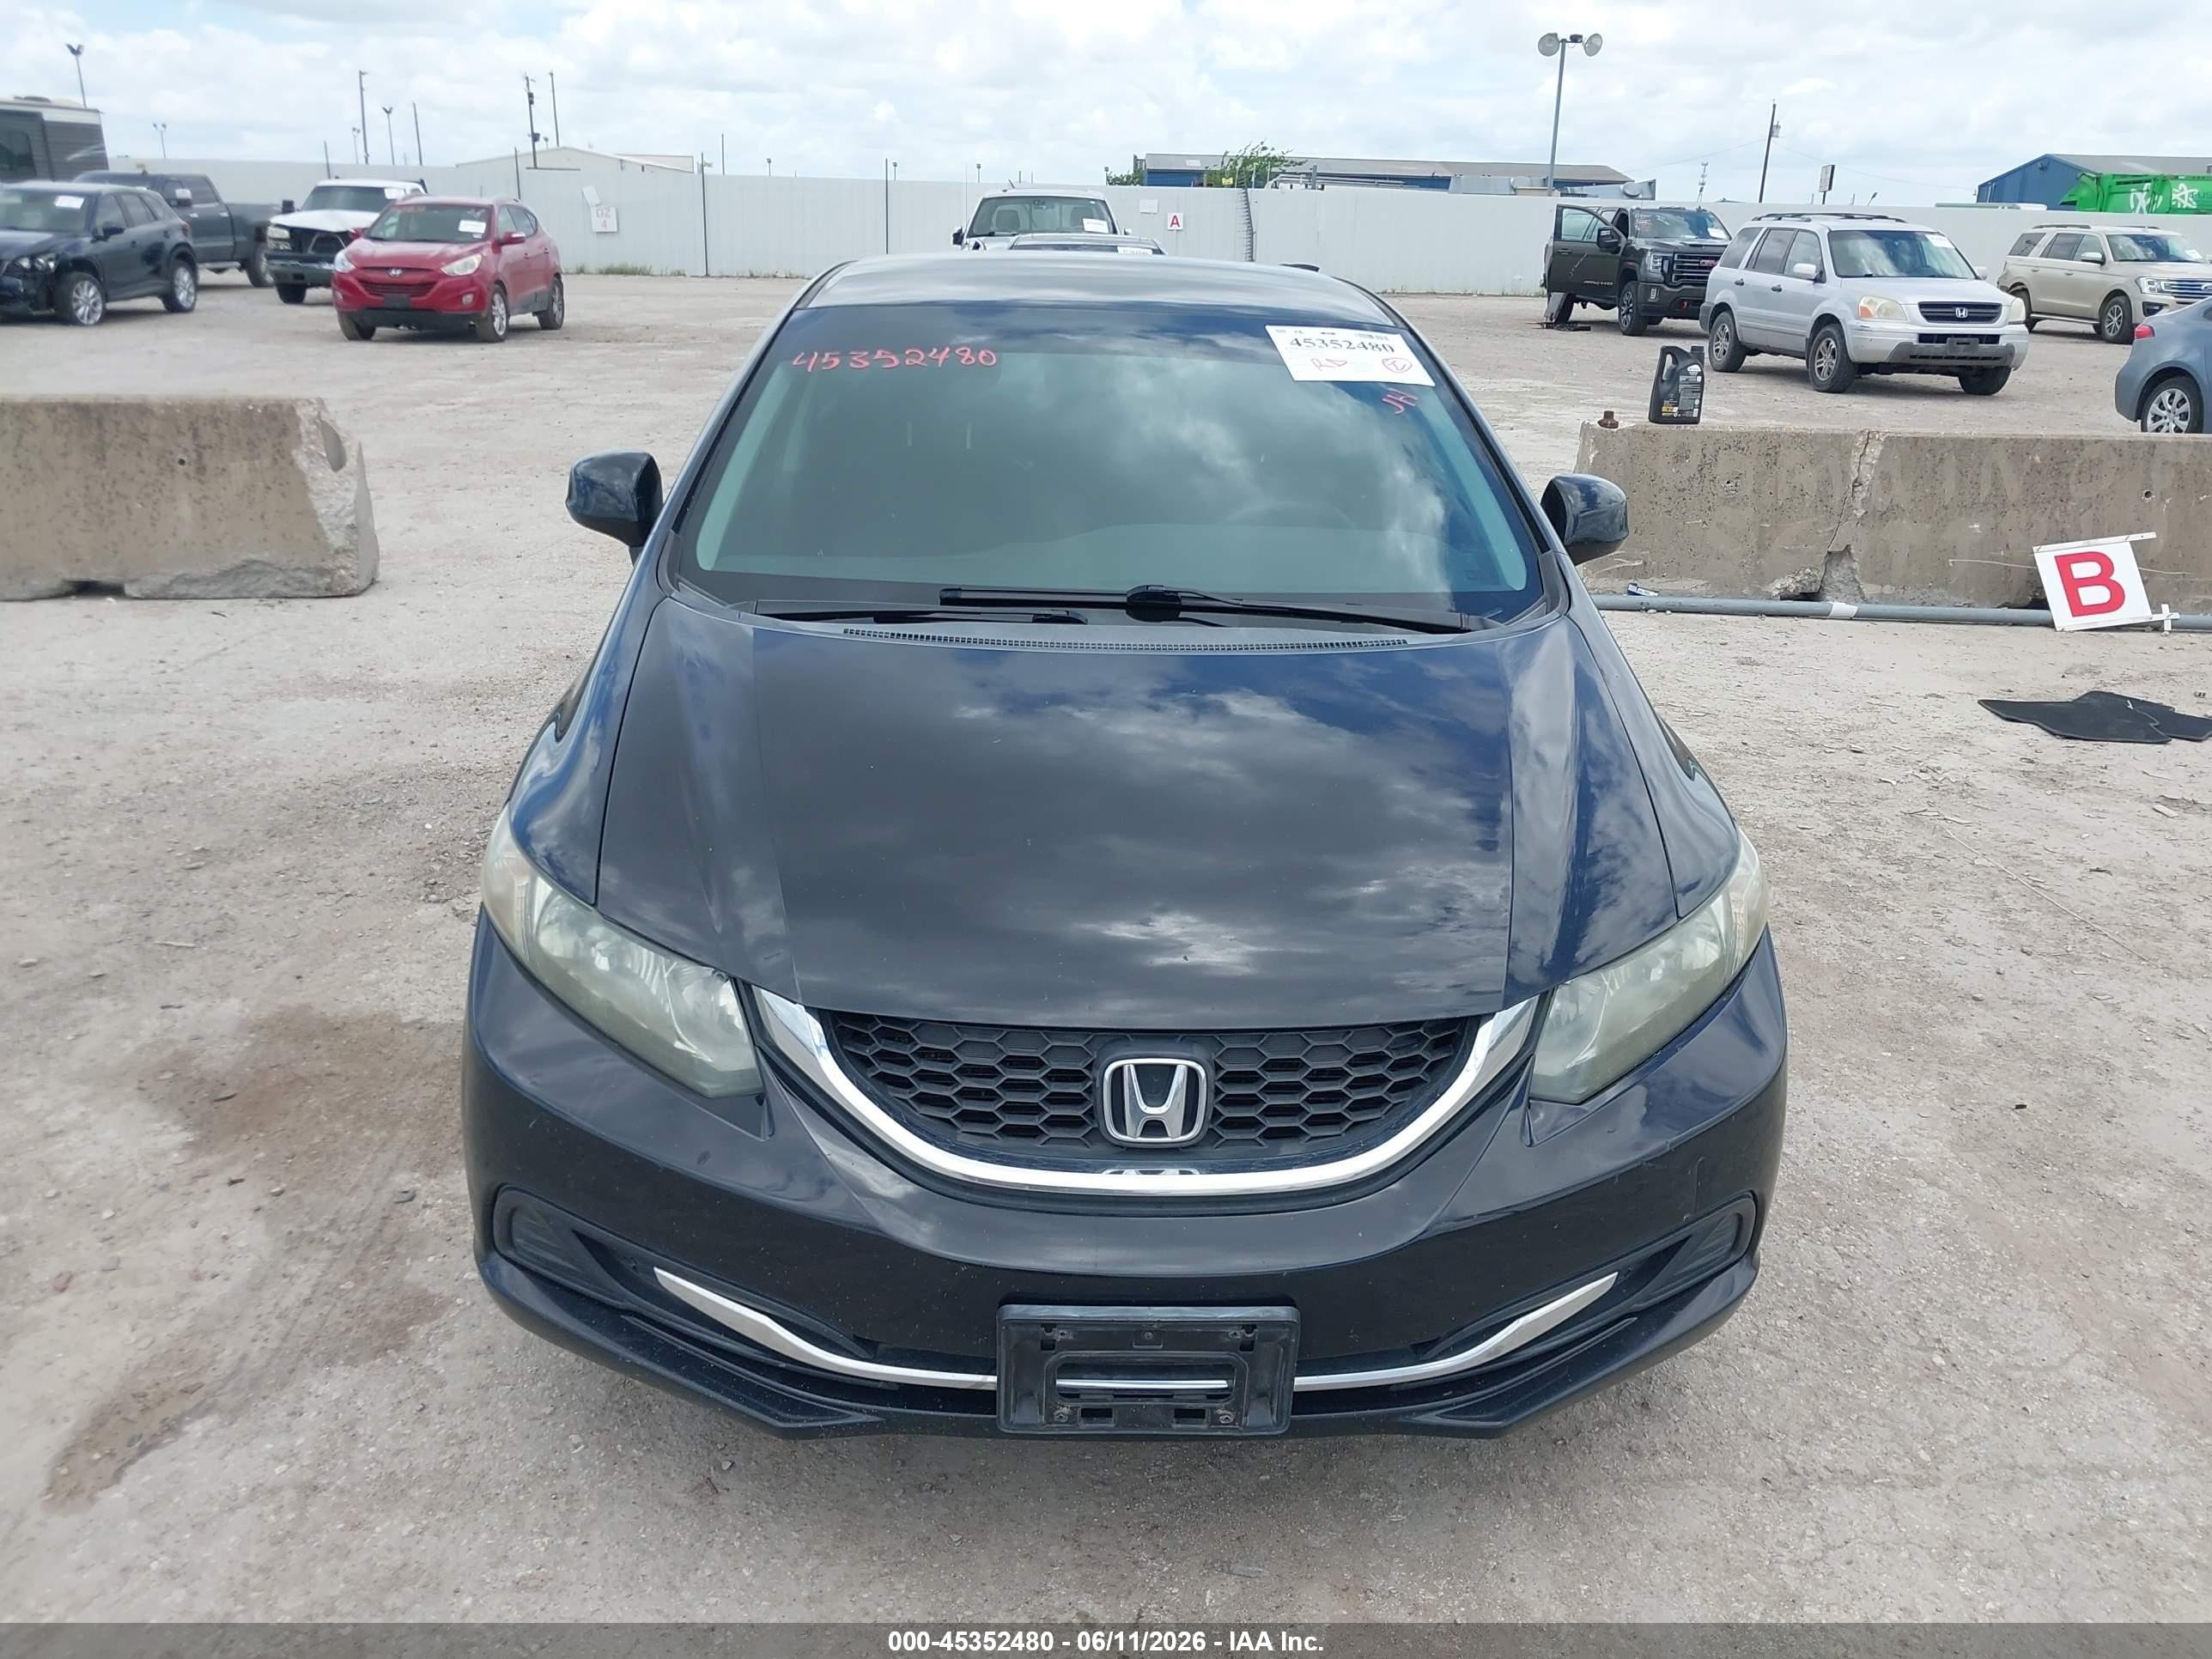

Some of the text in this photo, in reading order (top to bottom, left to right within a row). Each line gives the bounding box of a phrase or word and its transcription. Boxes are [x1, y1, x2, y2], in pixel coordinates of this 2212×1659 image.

[1170, 215, 1181, 228] A
[1290, 337, 1395, 354] 45352480
[2053, 550, 2126, 618] B
